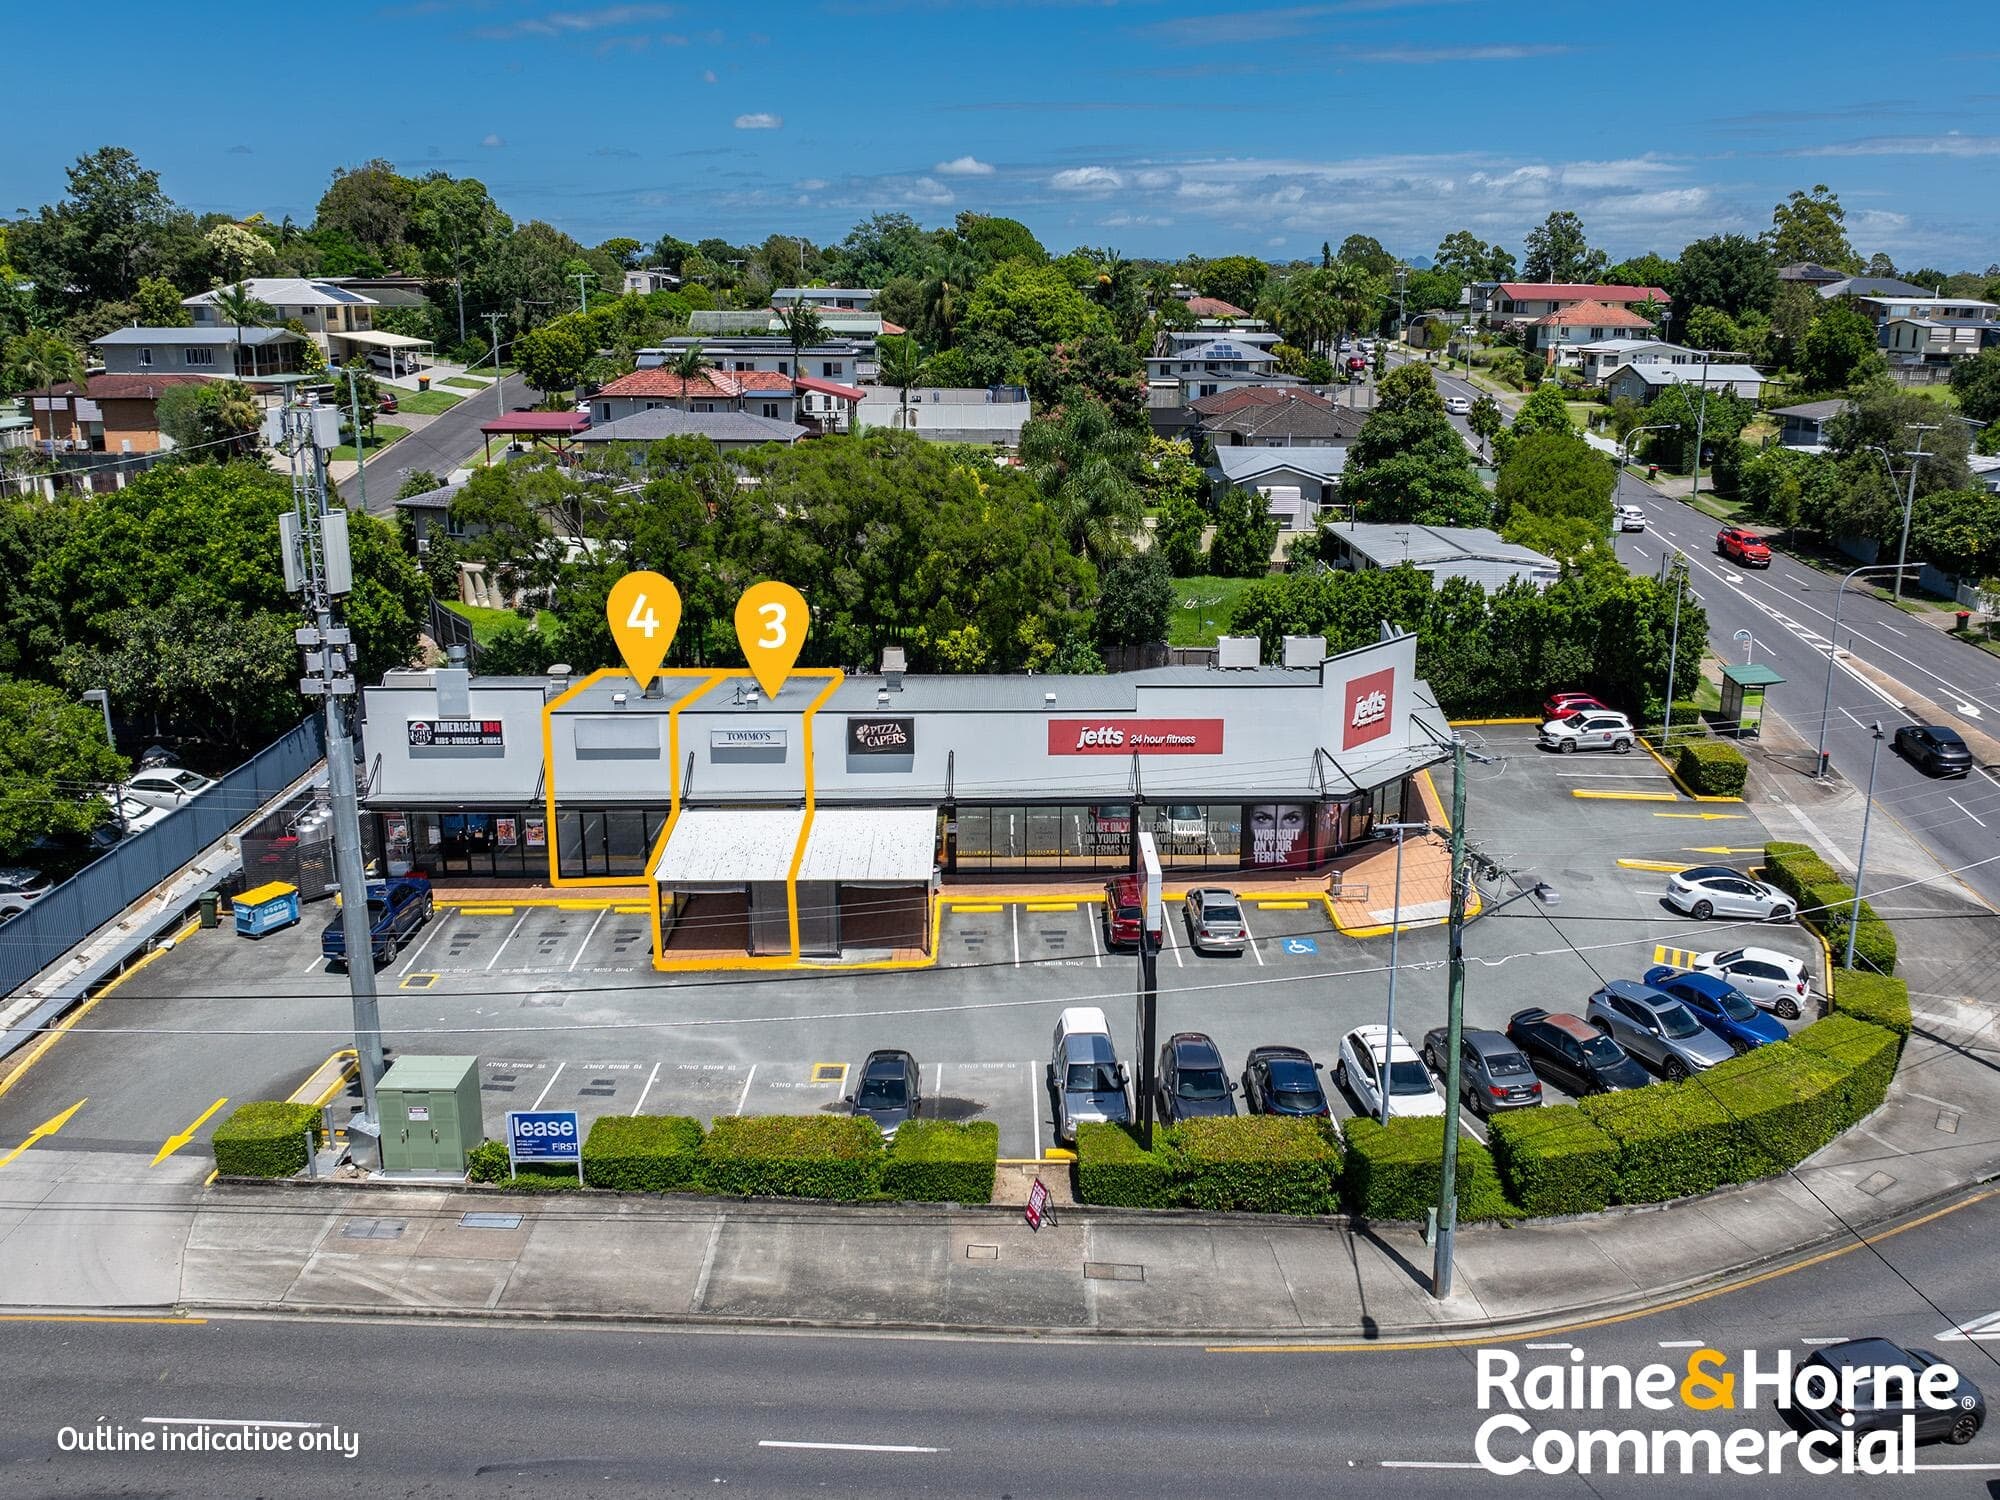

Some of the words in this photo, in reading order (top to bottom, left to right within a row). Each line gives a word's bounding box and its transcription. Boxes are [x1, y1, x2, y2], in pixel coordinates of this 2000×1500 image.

[1351, 690, 1387, 726] jetts
[434, 721, 482, 733] AMERICAN
[482, 721, 501, 733] BBQ
[869, 723, 902, 735] PIZZA
[434, 736, 450, 745] RIBS
[451, 736, 480, 745] BURGERS
[482, 736, 502, 745] WINGS
[726, 732, 771, 741] TOMMO'S
[866, 732, 907, 747] CAPERS
[1077, 726, 1124, 749] jetts
[1129, 734, 1143, 745] 24
[1143, 734, 1166, 745] hour
[1165, 733, 1197, 745] fitness
[1097, 833, 1120, 844] YOUR
[1254, 829, 1300, 841] WORKOUT
[1089, 844, 1120, 855] TERMS
[1253, 840, 1267, 852] ON
[513, 1116, 574, 1137] lease
[551, 1141, 578, 1152] FIRST
